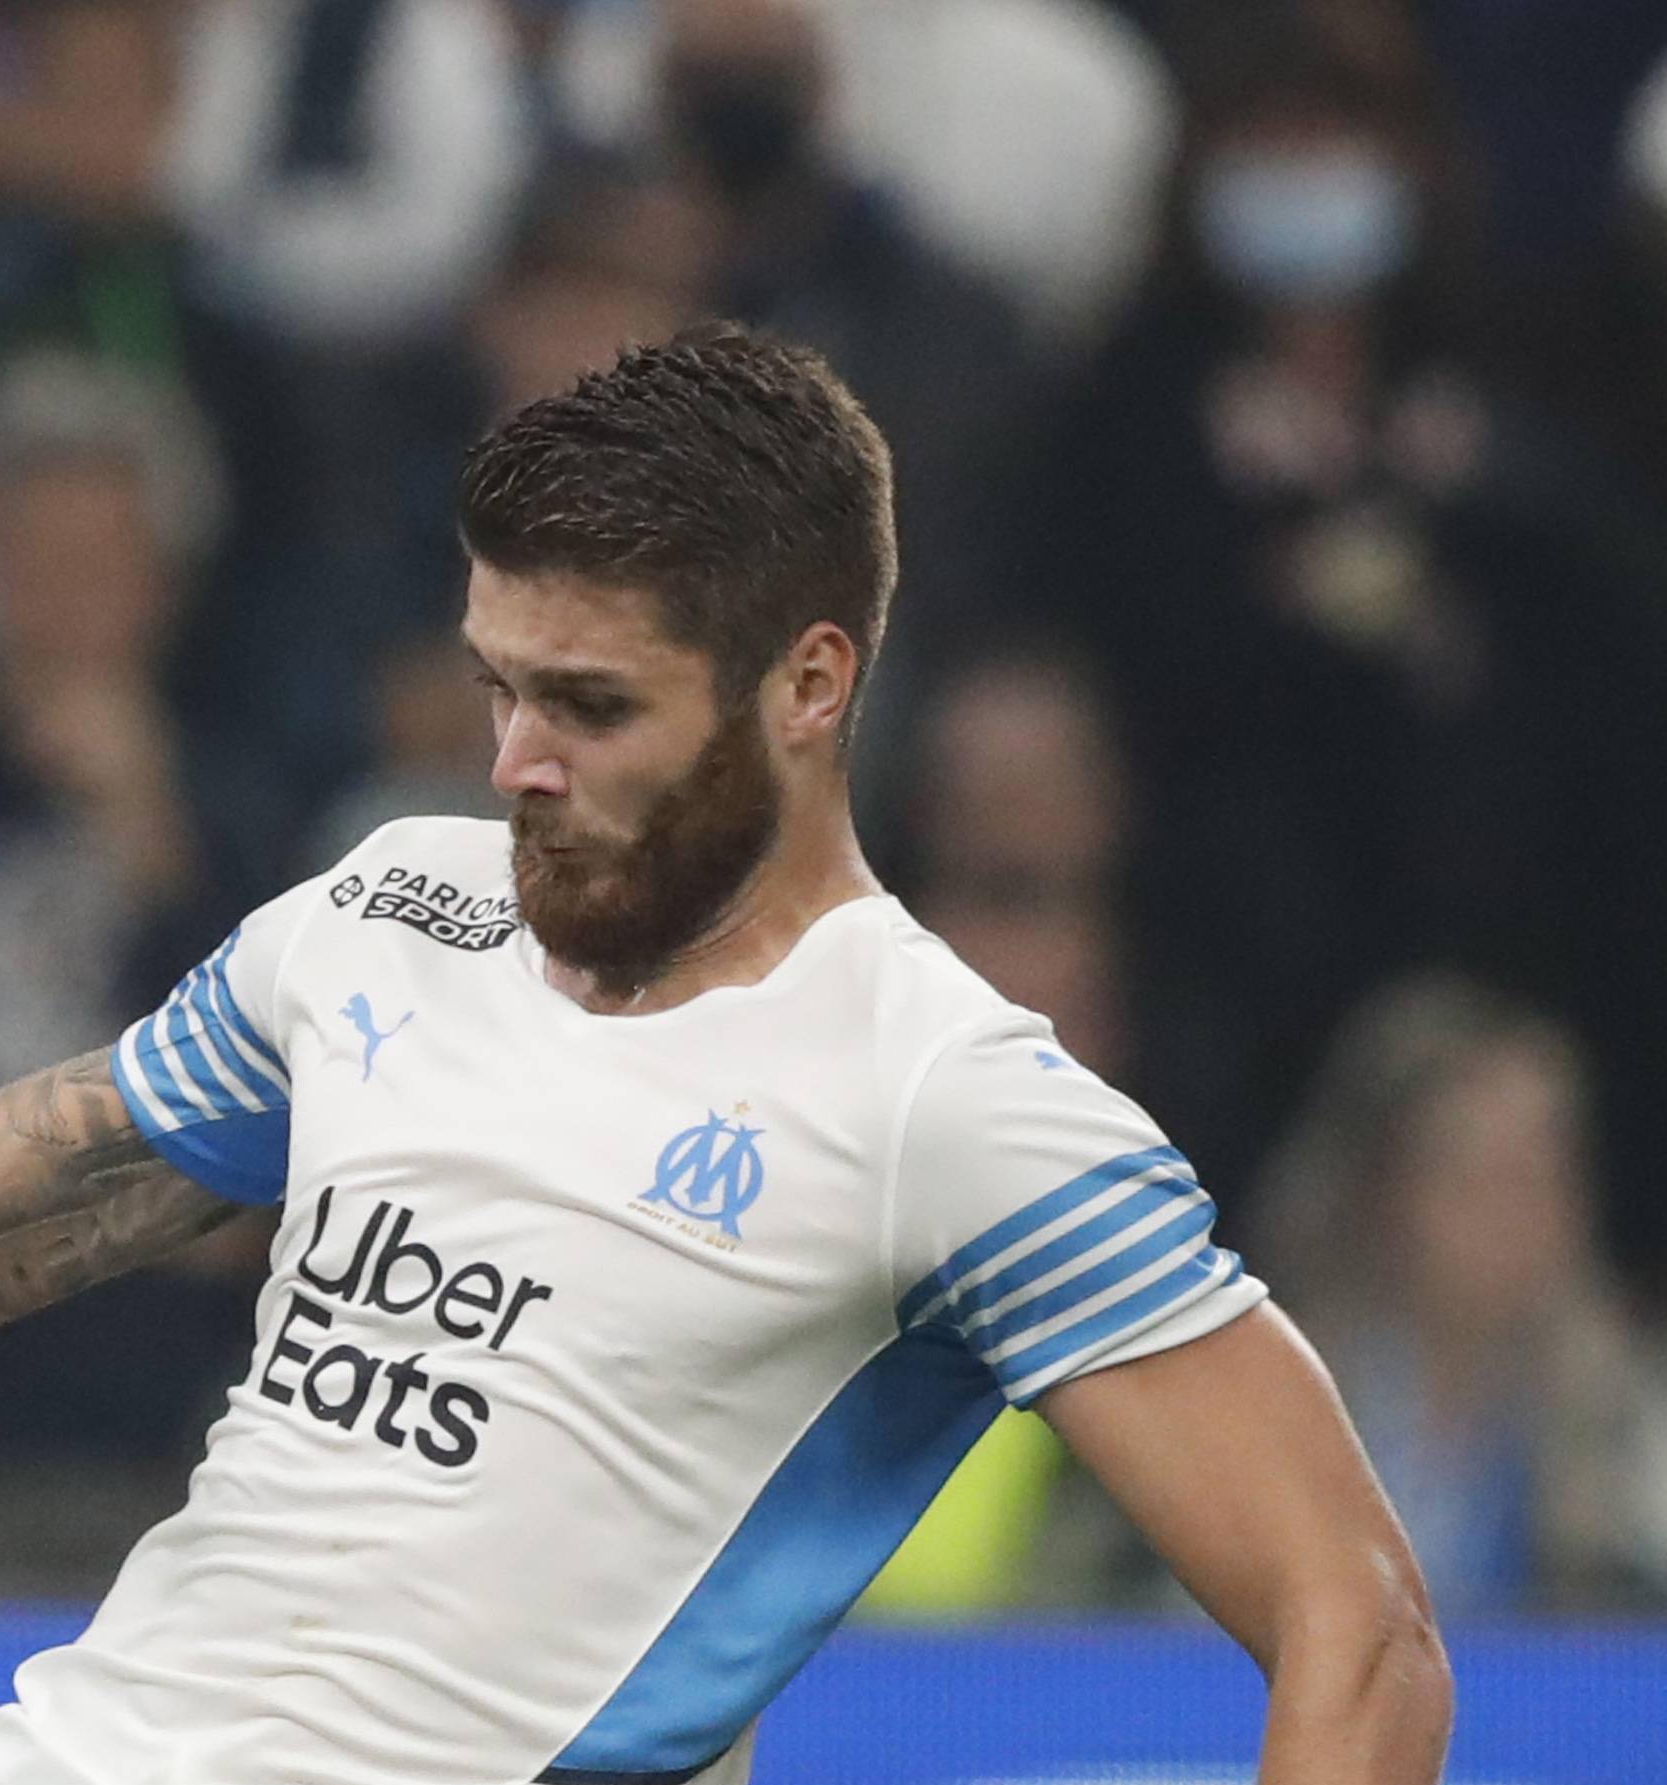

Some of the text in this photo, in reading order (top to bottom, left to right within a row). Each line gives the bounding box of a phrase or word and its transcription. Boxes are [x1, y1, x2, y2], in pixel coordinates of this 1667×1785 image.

[367, 896, 513, 949] SPORT
[378, 867, 518, 921] PARION
[297, 1185, 554, 1352] Uber
[259, 1288, 491, 1468] Eats
